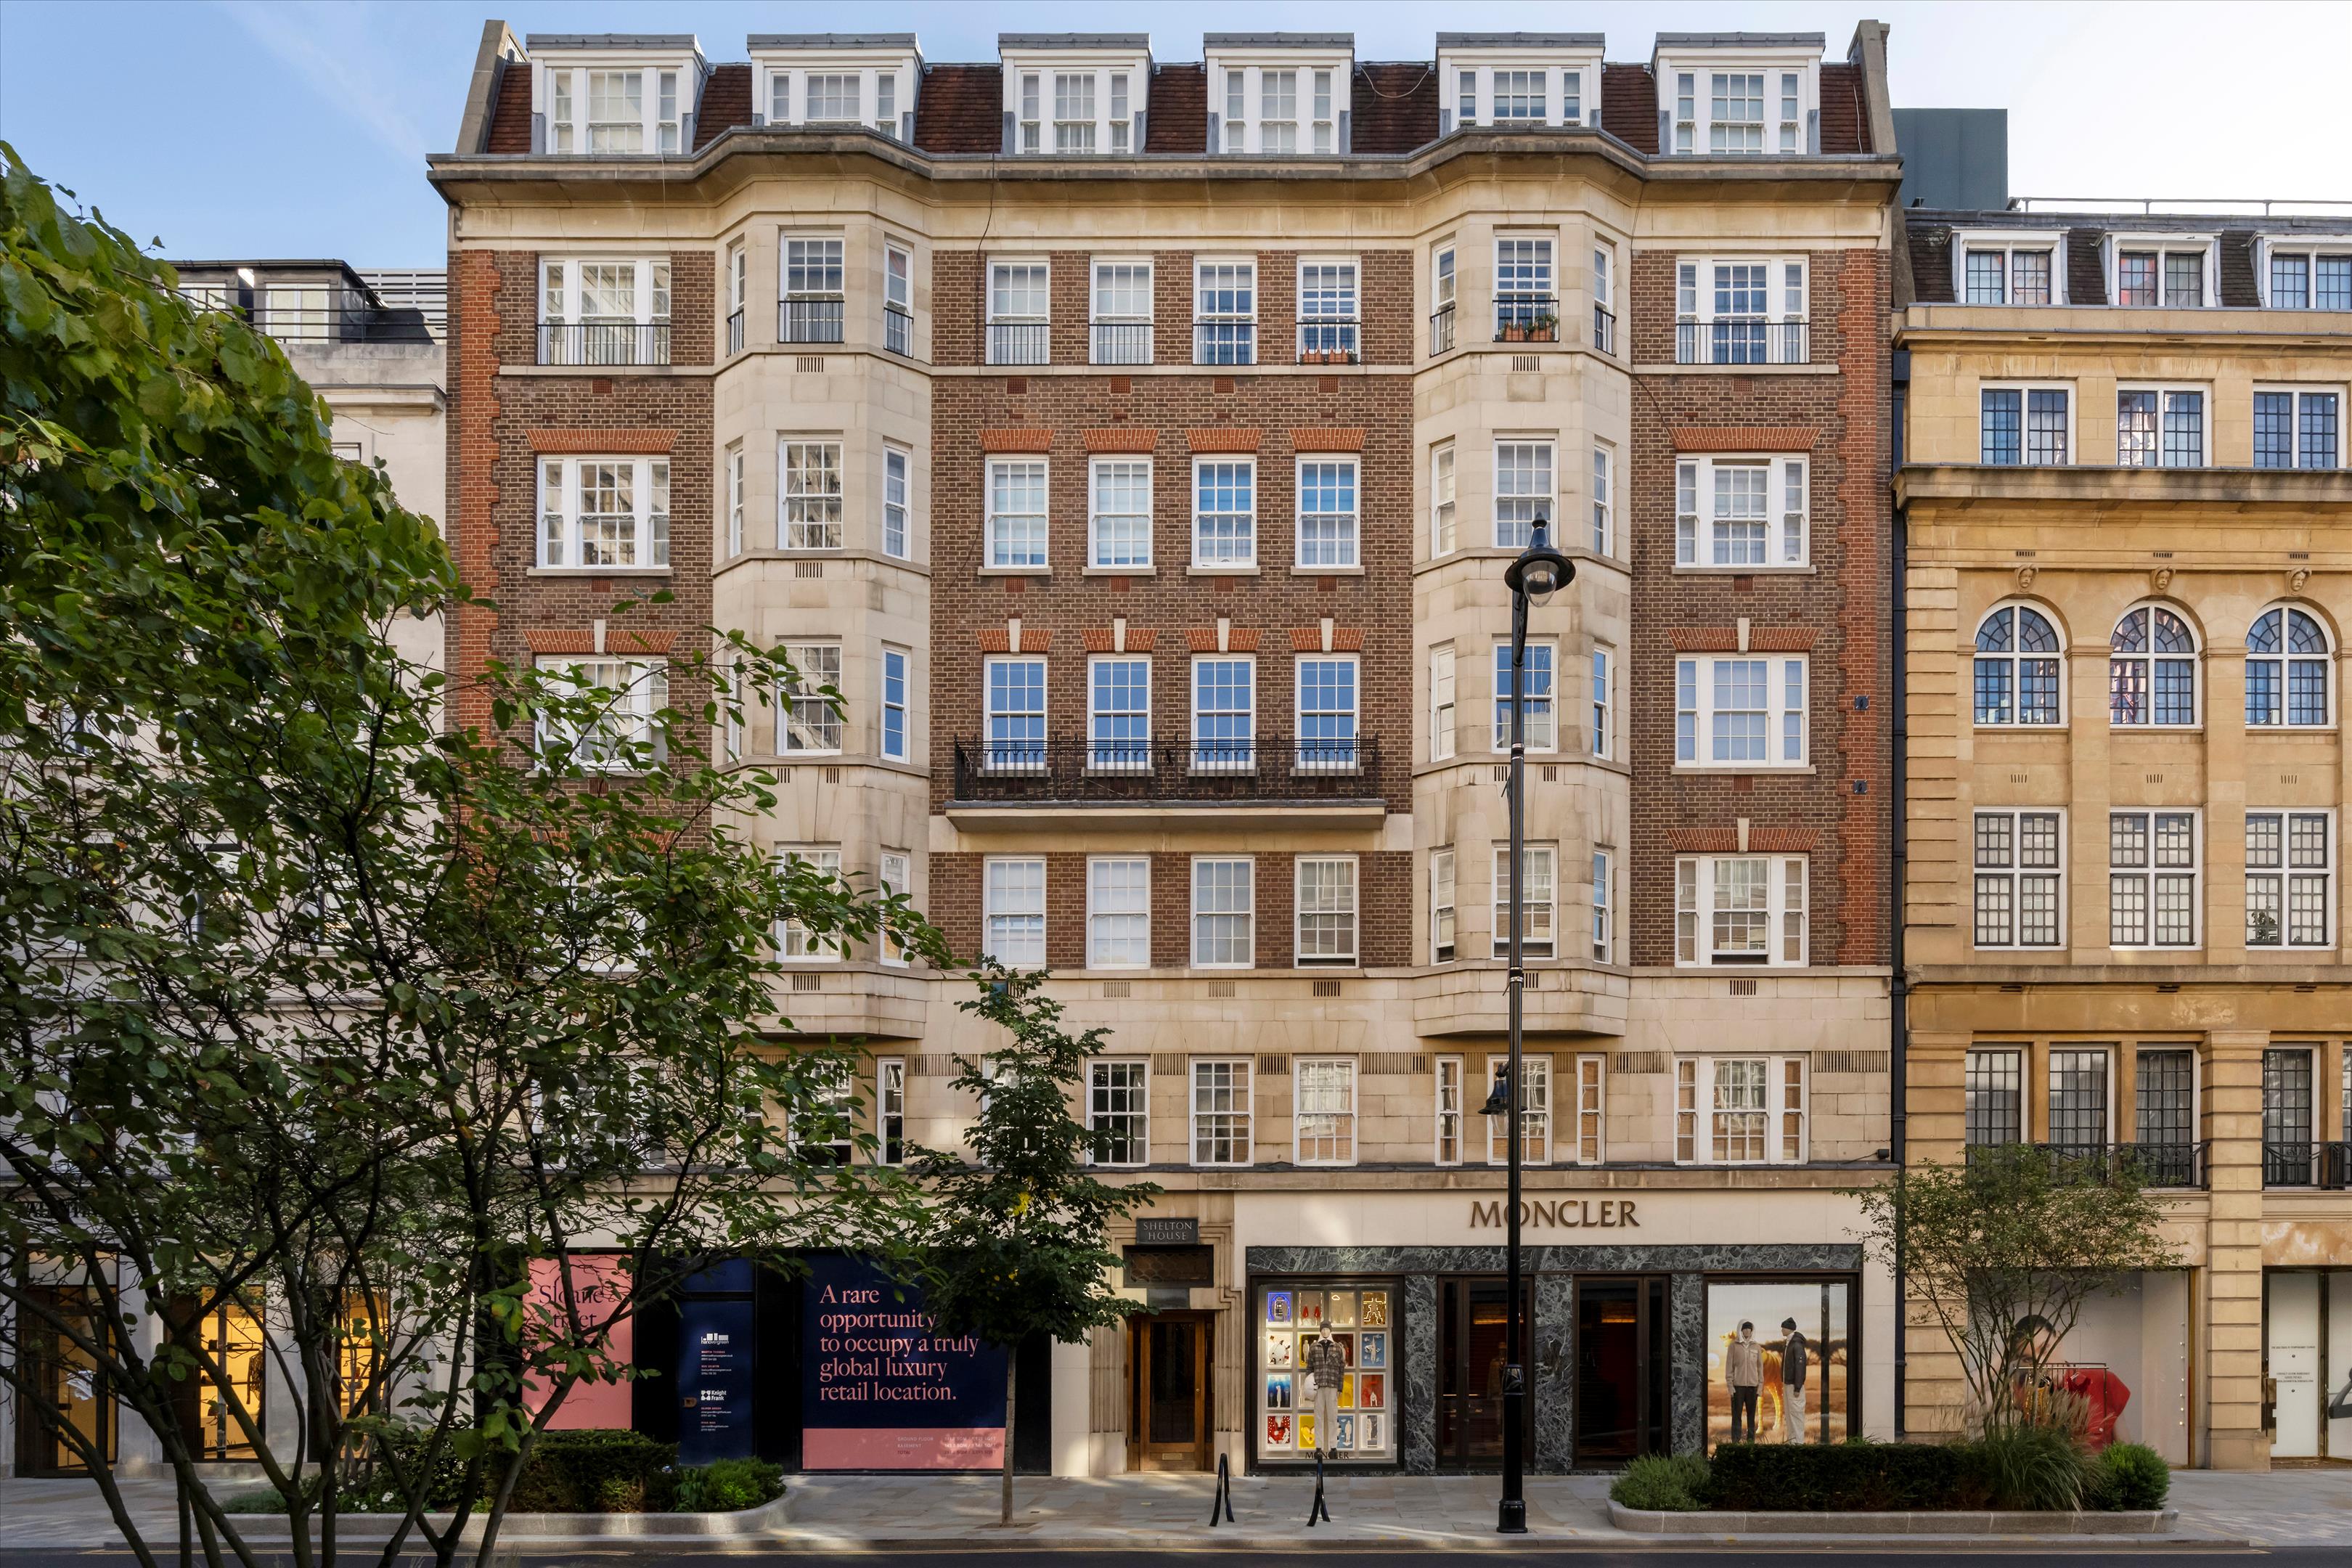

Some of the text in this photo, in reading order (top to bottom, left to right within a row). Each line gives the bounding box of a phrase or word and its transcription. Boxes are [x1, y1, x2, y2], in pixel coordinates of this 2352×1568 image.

[1469, 1200, 1641, 1228] MONCLER
[1143, 1222, 1192, 1230] SHELTON
[1148, 1232, 1187, 1241] HOUSE
[820, 1283, 880, 1304] A rare
[539, 1309, 597, 1328] tret
[820, 1309, 937, 1334] opportunity
[820, 1335, 979, 1357] to occupy a truly
[820, 1357, 947, 1382] global luxury
[820, 1381, 957, 1401] retail location.
